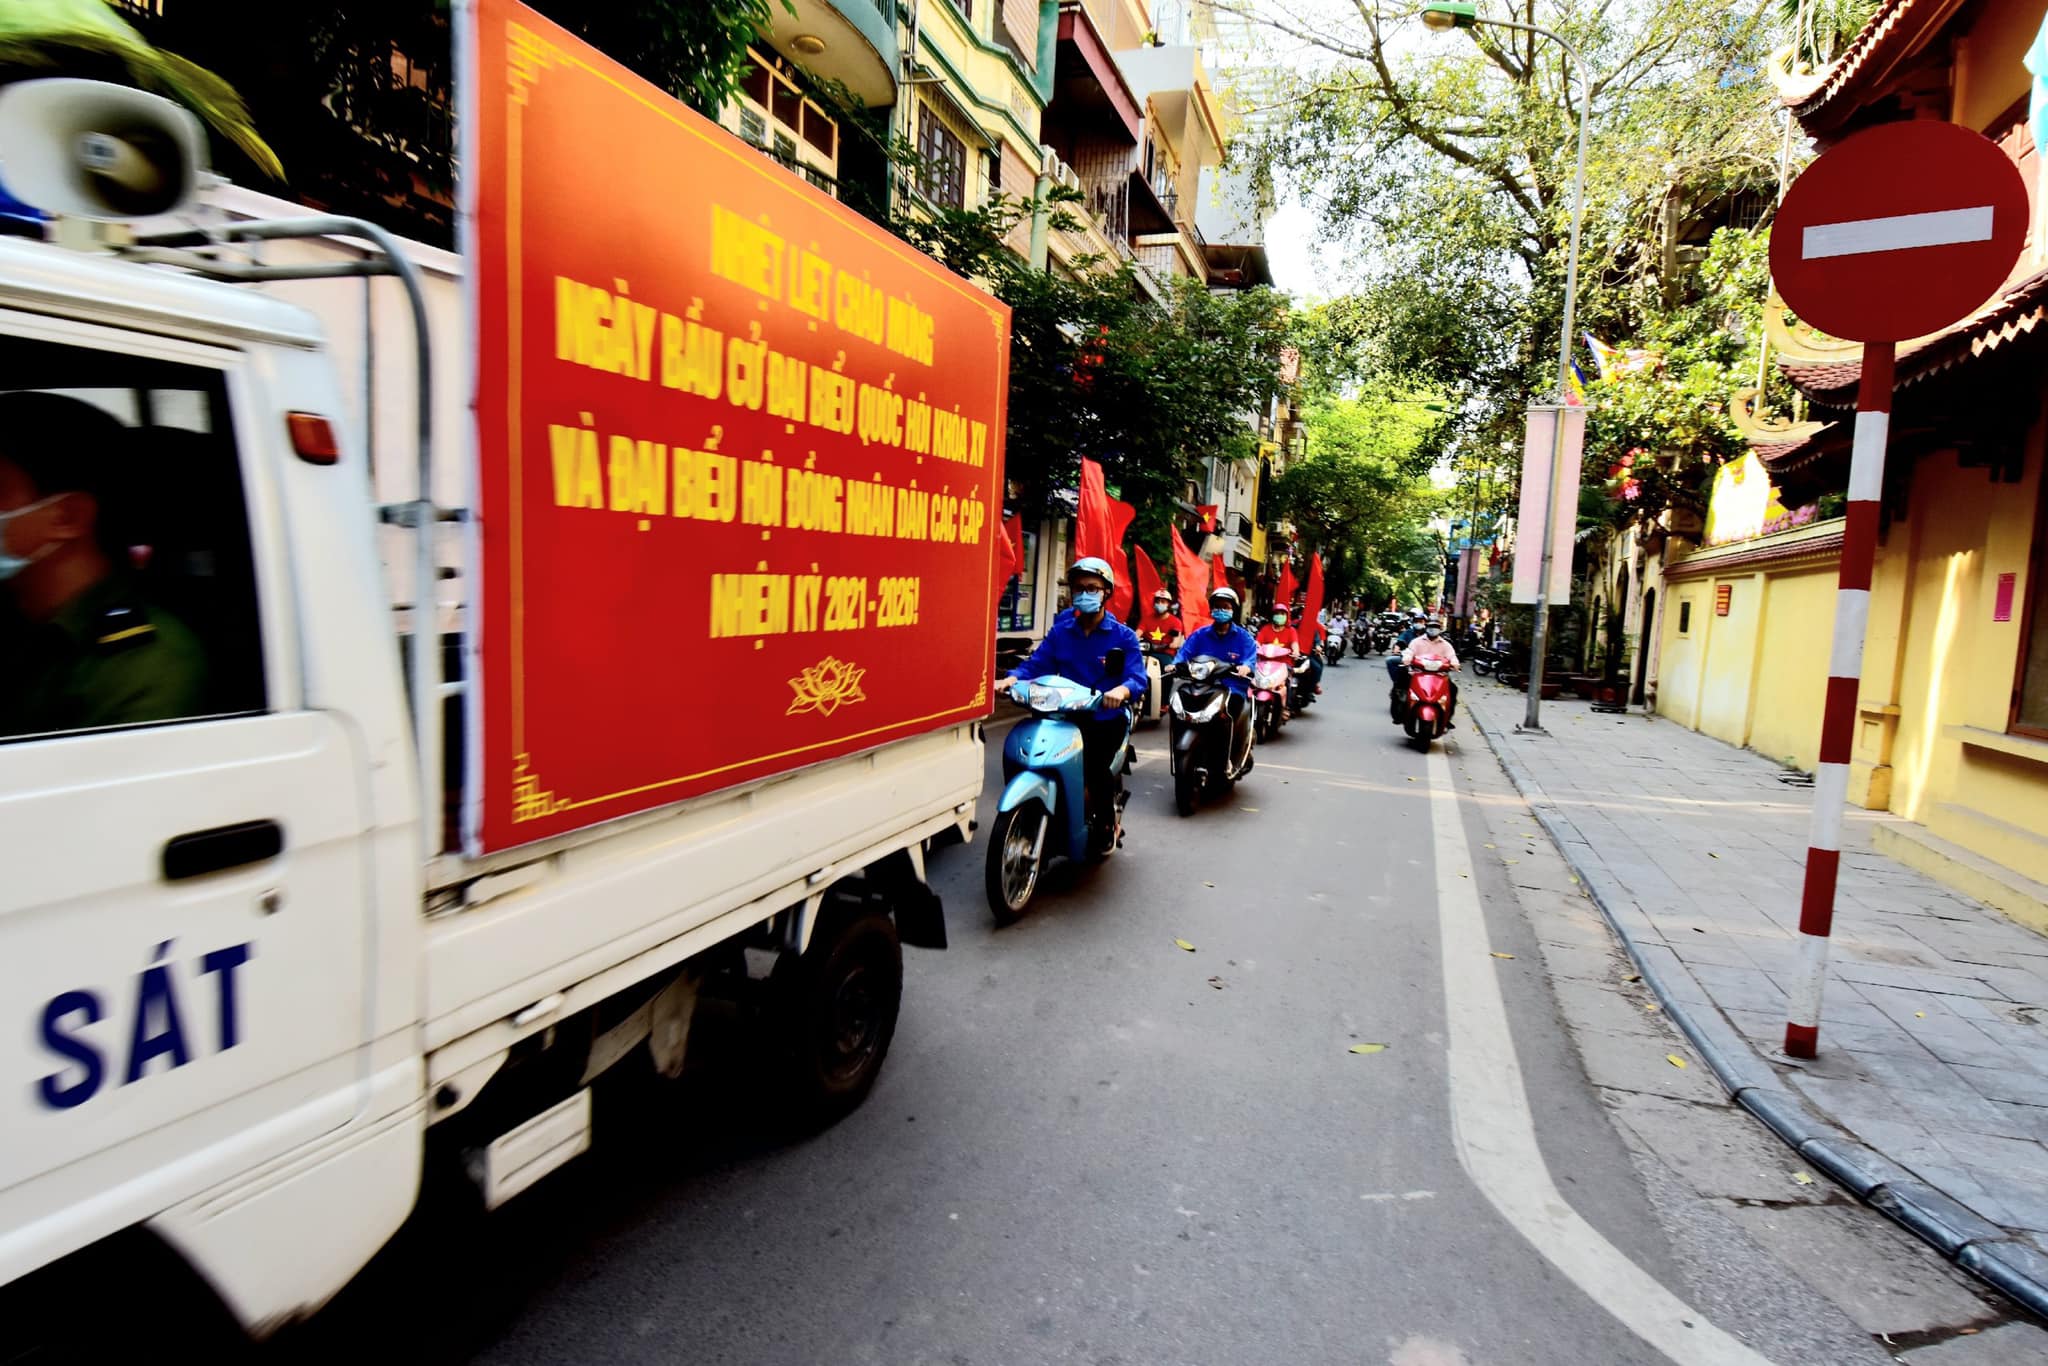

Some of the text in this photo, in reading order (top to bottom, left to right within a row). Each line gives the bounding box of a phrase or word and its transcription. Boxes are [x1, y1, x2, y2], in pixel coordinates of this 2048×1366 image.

[710, 203, 785, 312] NHIỆT
[788, 241, 832, 331] LỆT
[835, 269, 884, 345] CHÀO
[554, 275, 987, 468] NGÀY BẦU CỬ ĐẠI BIỂU QUỐC HỘI KHÓA XV
[548, 411, 985, 544] VÀ ĐẠI BIỂU HỘI ĐỒNG NHÂN DÂN CÁC CẤP
[709, 560, 790, 650] NHIỆM
[792, 562, 822, 633] KỲ
[823, 576, 867, 631] 2021
[876, 576, 920, 628] 2026!
[34, 936, 257, 1110] SÁT
